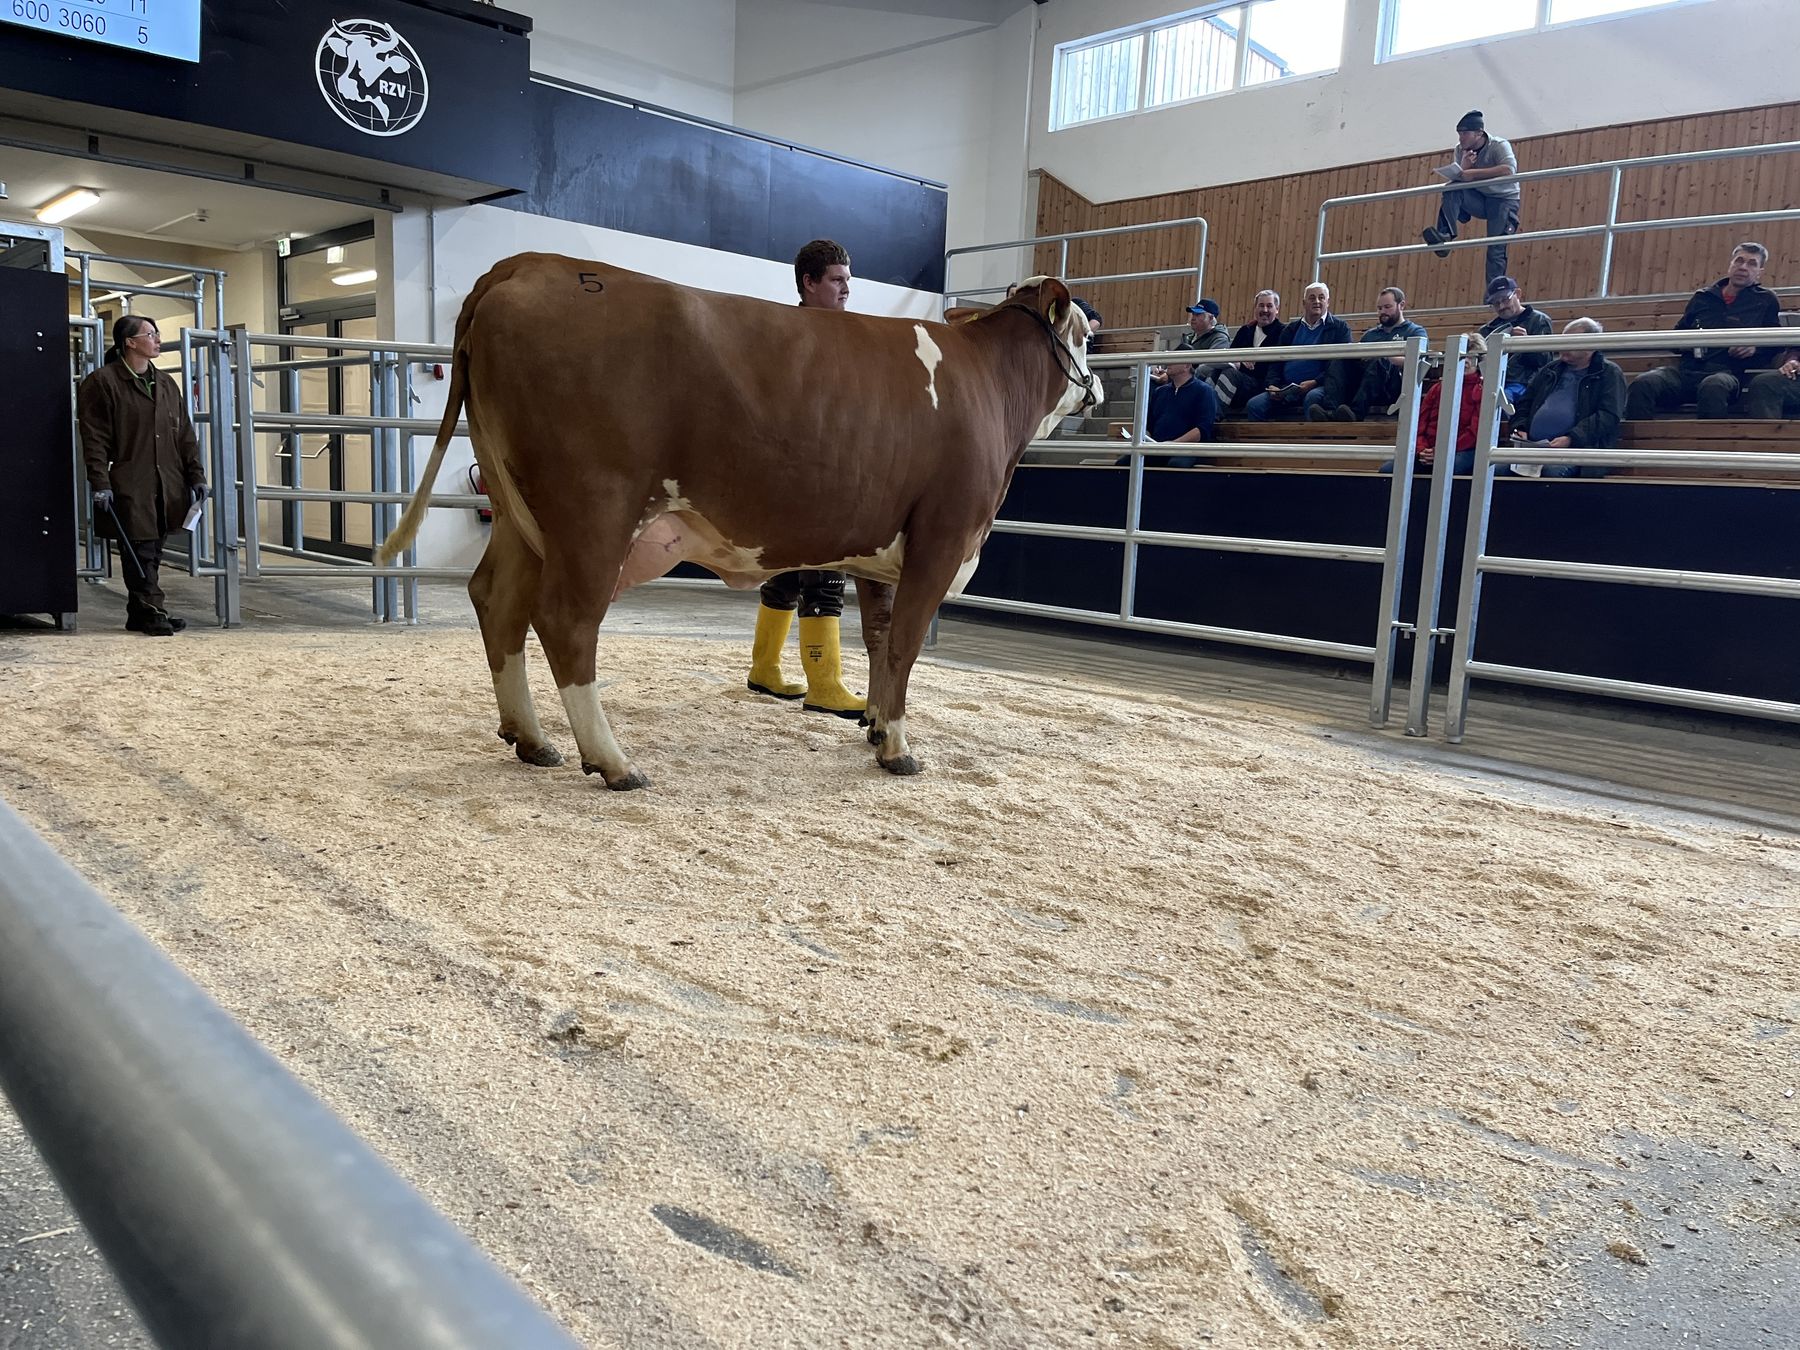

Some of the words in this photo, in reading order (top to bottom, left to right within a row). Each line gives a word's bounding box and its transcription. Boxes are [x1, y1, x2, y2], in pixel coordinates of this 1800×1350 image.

[12, 0, 50, 22] 600
[58, 7, 107, 35] 3060
[137, 25, 149, 45] 5
[379, 79, 407, 99] RZV
[578, 272, 604, 293] 5
